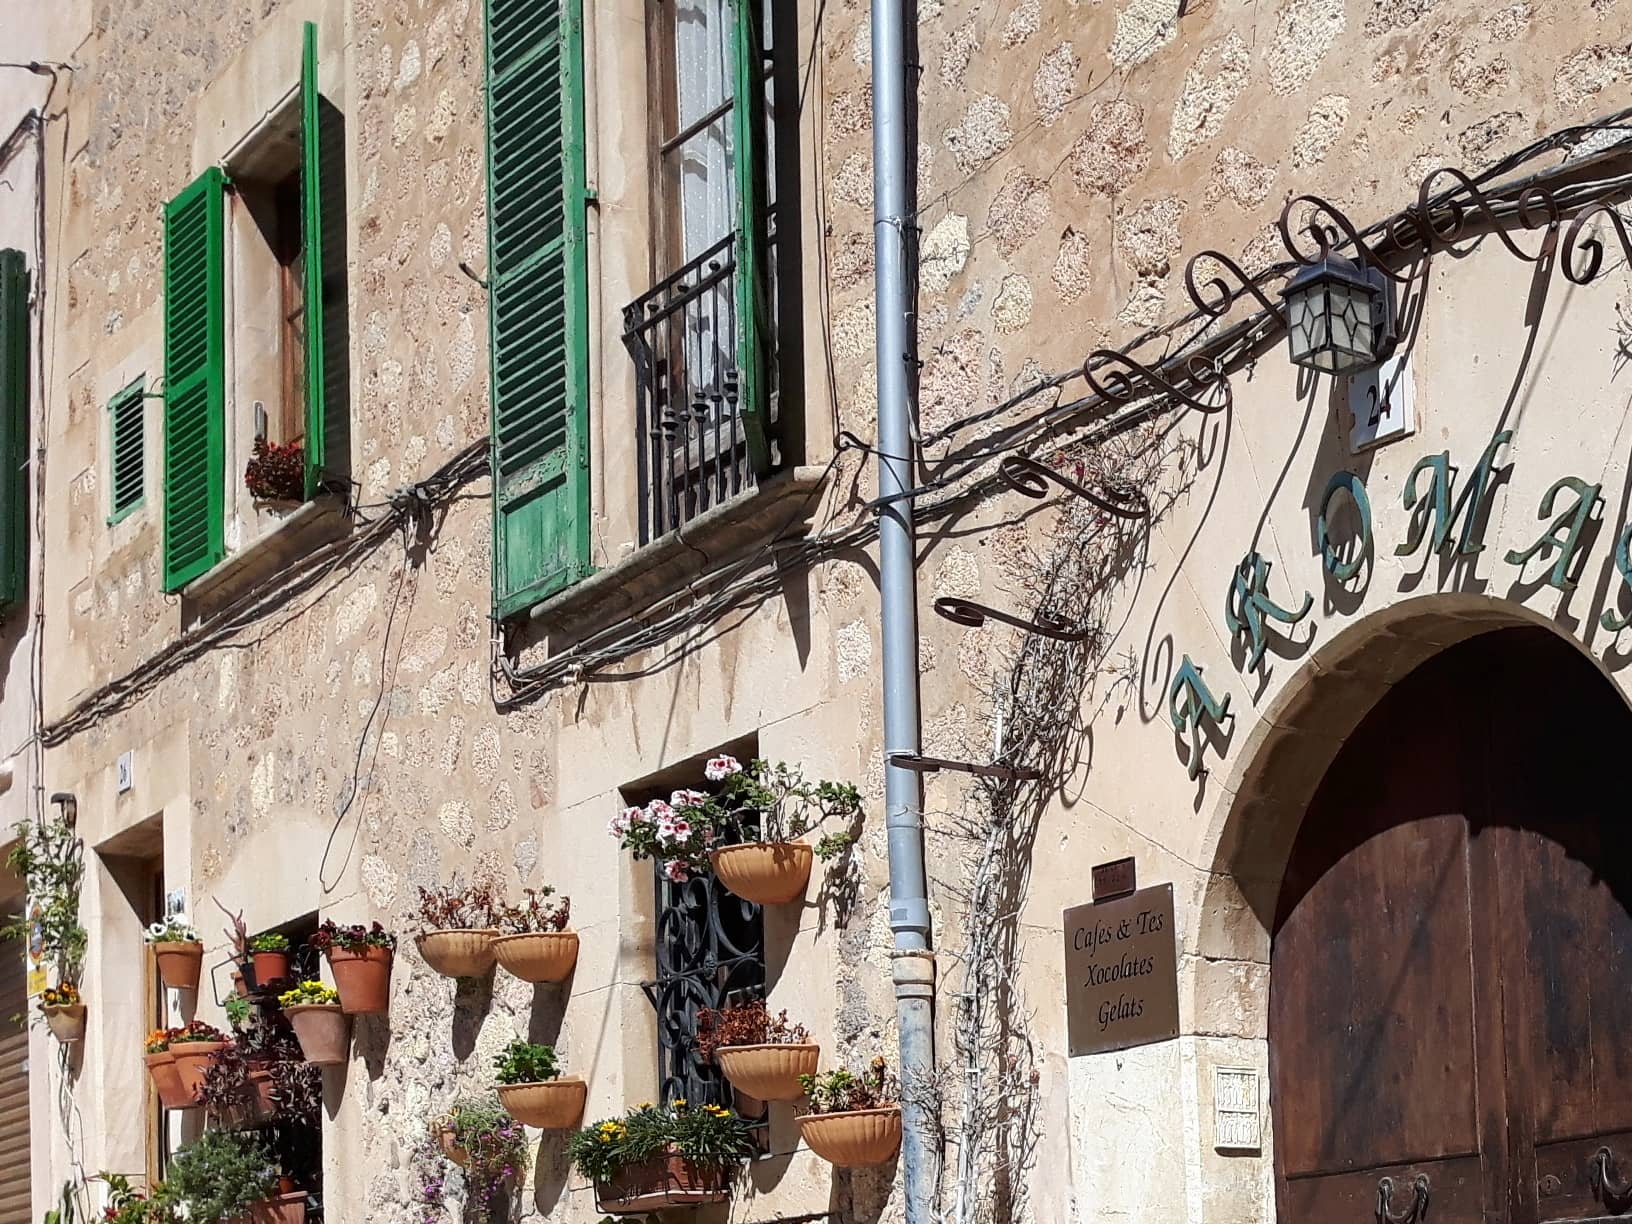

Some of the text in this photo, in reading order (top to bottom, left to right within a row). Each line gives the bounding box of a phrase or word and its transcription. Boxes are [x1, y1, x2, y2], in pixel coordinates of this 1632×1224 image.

[1366, 378, 1392, 428] 24
[1074, 909, 1164, 957] Cafes & Tes
[1084, 952, 1154, 988] Xocolates
[1098, 993, 1144, 1032] Gelats
